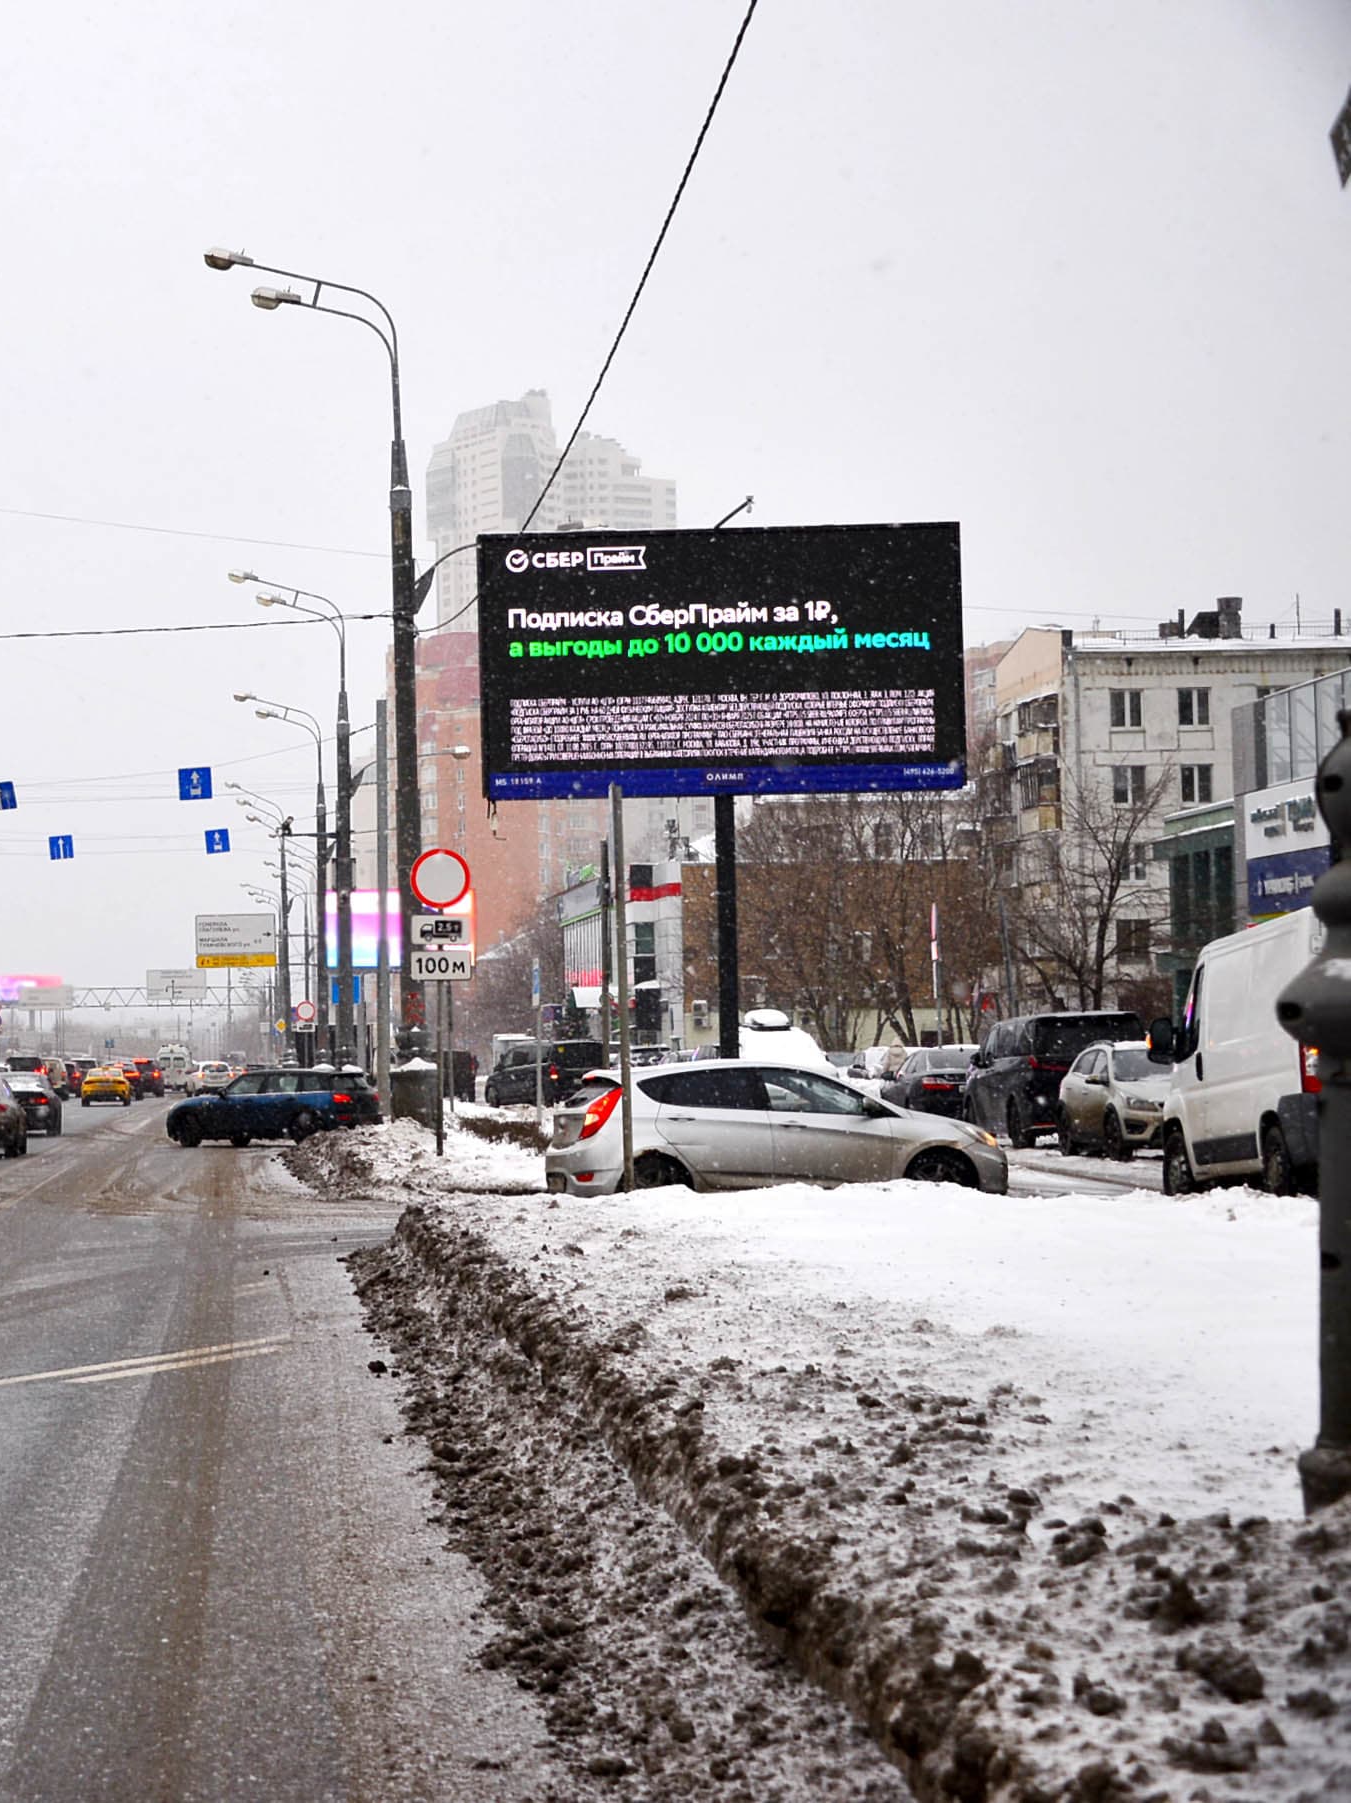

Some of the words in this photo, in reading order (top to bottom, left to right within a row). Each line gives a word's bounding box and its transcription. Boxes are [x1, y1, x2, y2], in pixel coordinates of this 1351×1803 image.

[531, 552, 584, 568] СБЕР
[593, 552, 636, 567] Прайм
[508, 608, 624, 631] Подписка
[629, 602, 768, 629] СберПрайм
[773, 605, 800, 623] за
[509, 642, 524, 657] а
[529, 640, 623, 659] выгоды
[627, 638, 660, 658] до
[664, 632, 692, 654] 10
[696, 631, 744, 654] 000
[749, 628, 849, 653] каждый
[854, 632, 931, 650] месяц
[706, 772, 744, 781] ОЛИМП
